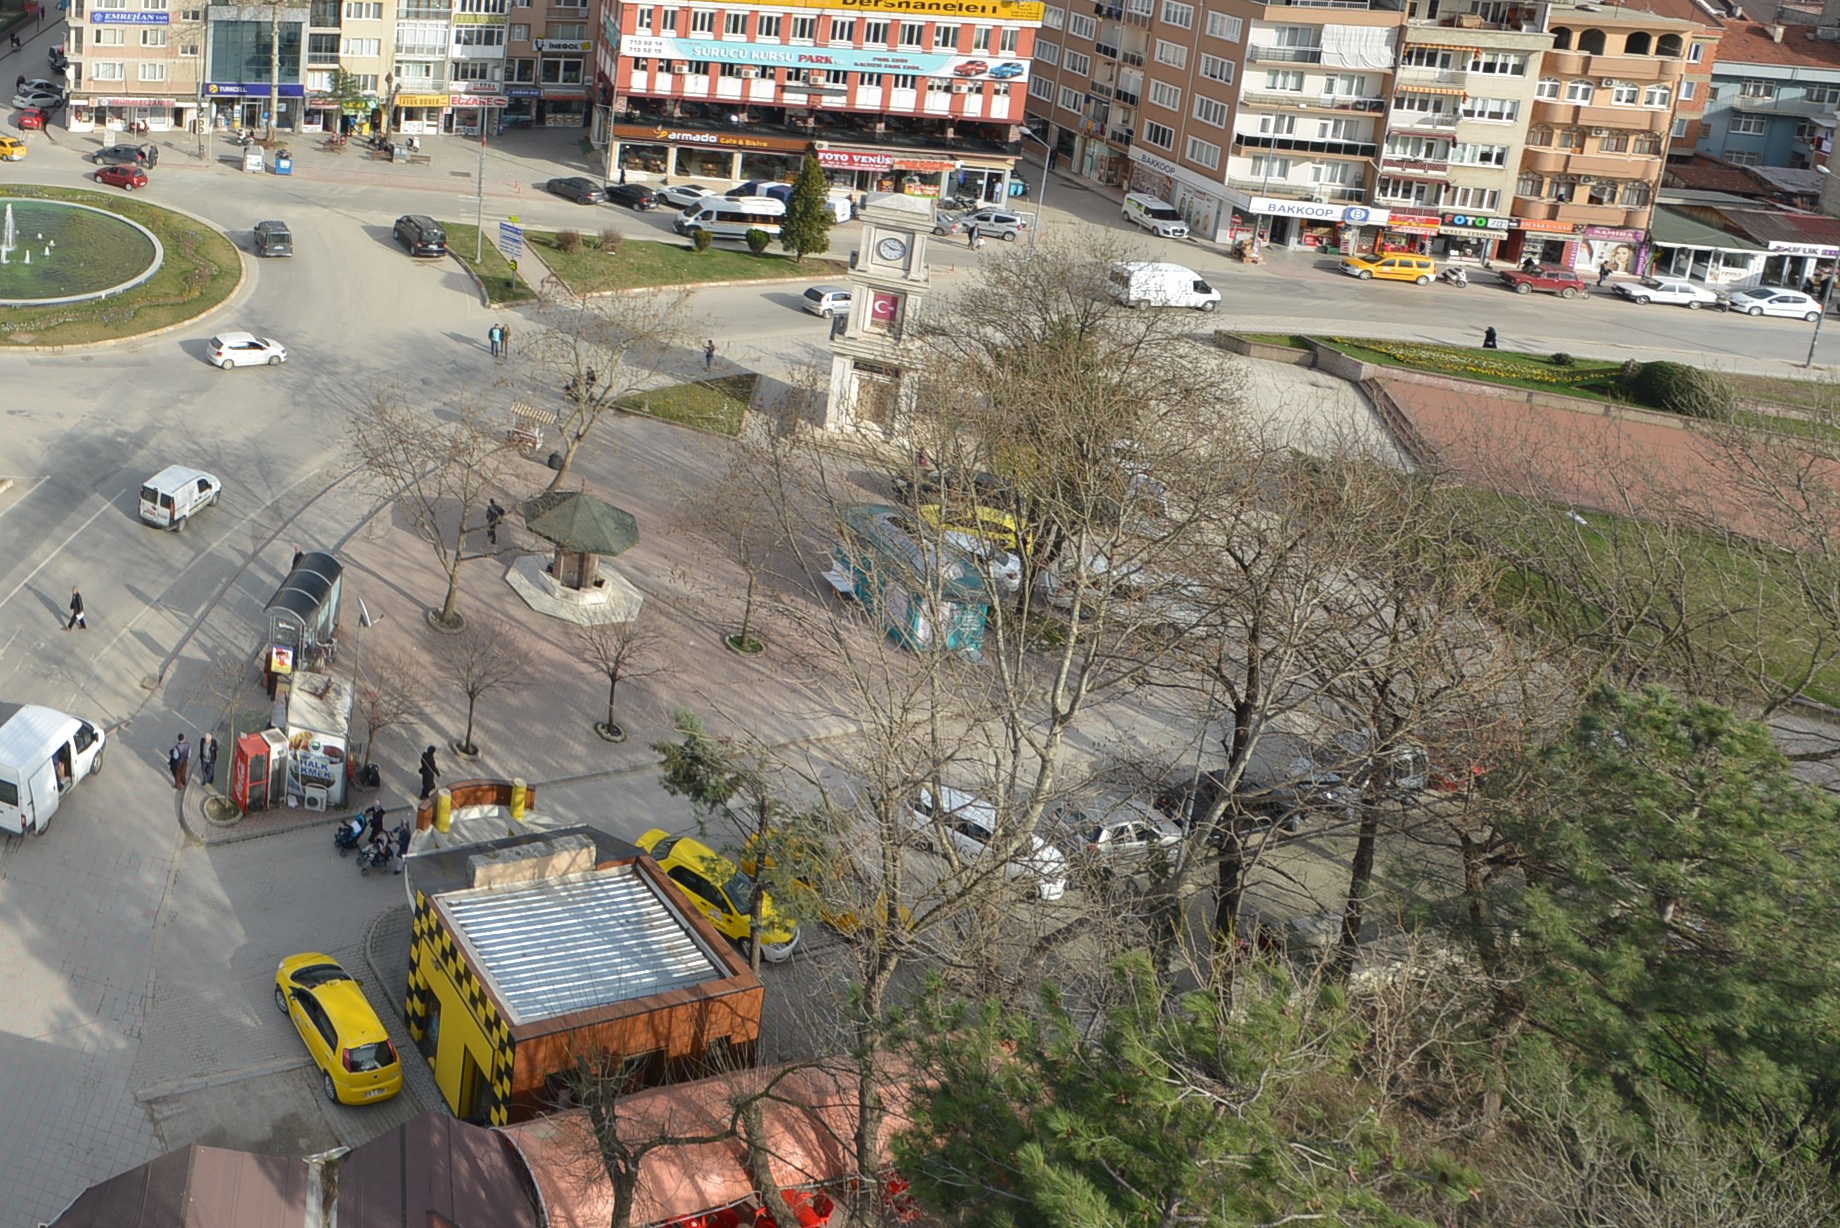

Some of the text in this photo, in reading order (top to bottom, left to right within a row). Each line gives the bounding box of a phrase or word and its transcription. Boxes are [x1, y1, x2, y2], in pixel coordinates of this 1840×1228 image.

[751, 50, 794, 62] KURSU
[797, 53, 834, 65] PARK
[451, 96, 493, 107] ECZANE
[668, 130, 718, 143] armado
[818, 152, 892, 165] FOTO VENÜS
[1141, 154, 1176, 175] BAKKOOP
[1267, 203, 1334, 218] BAKKOOP
[1444, 213, 1487, 227] FOTO
[299, 758, 329, 771] HALK
